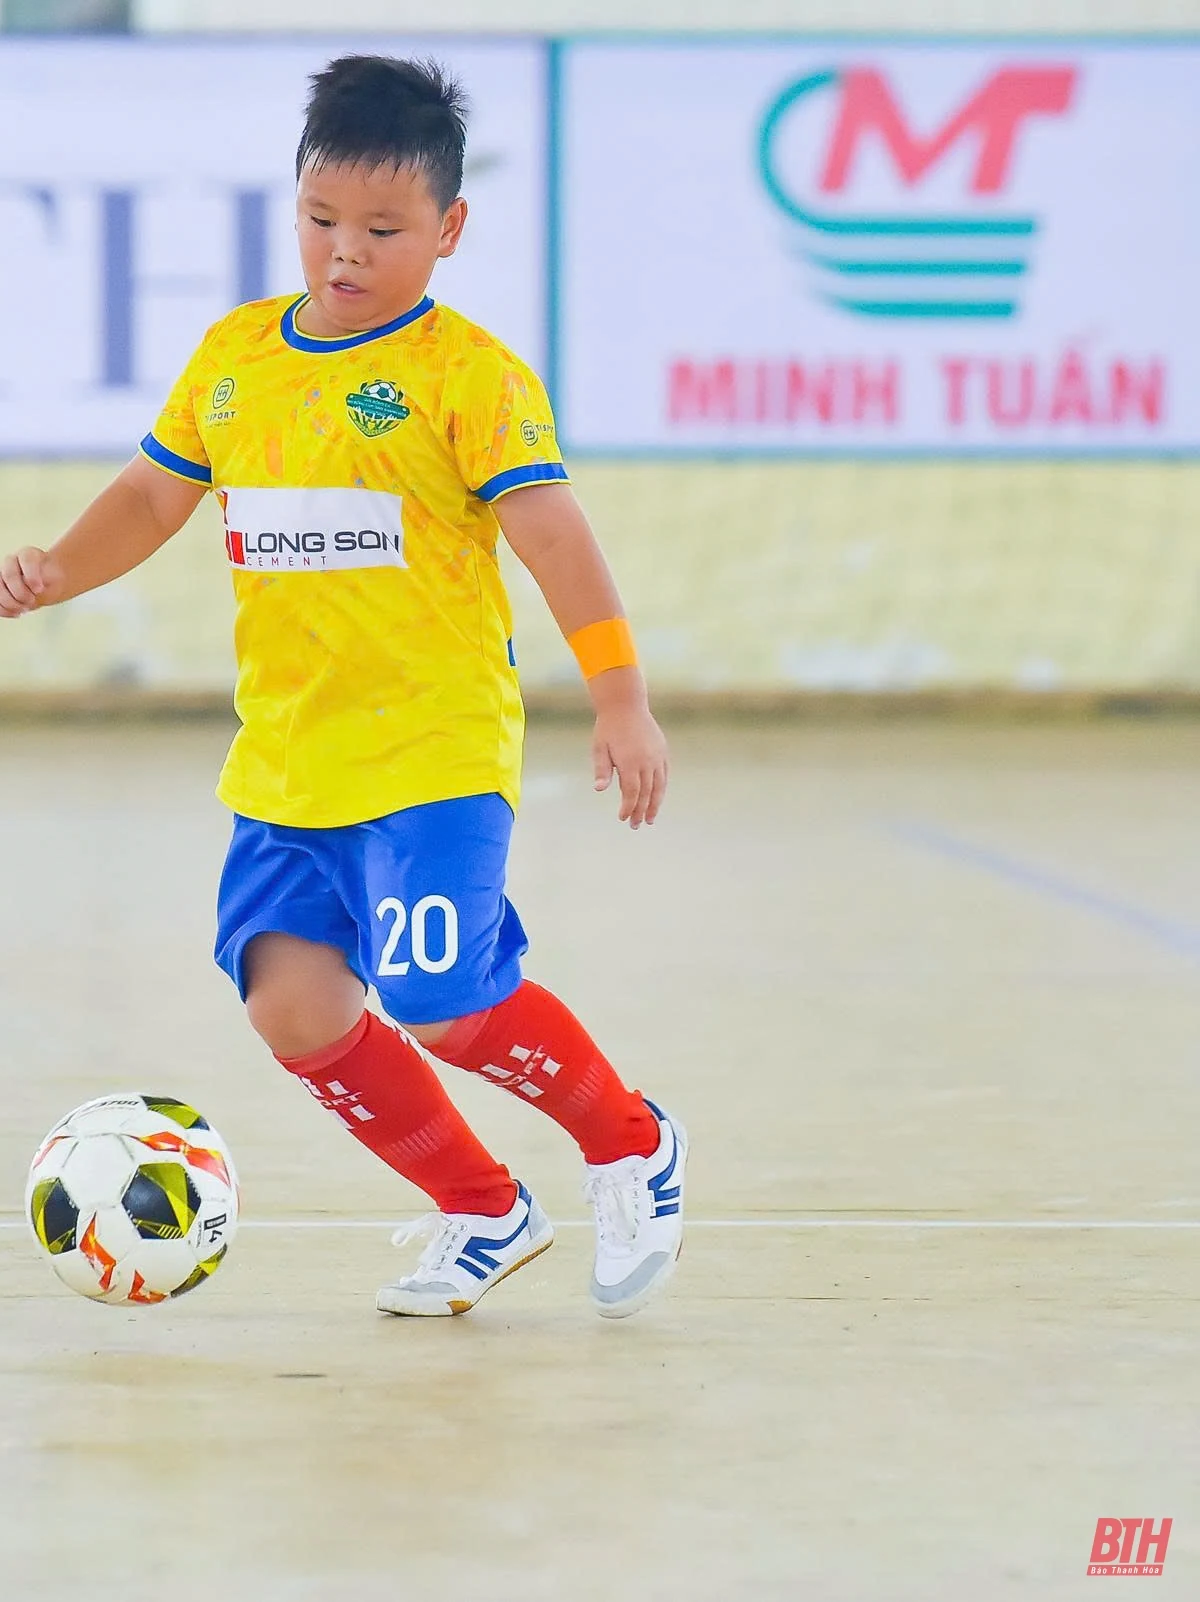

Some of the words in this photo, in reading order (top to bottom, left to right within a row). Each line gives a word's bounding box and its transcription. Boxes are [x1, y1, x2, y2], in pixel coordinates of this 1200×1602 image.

[668, 356, 898, 427] MINH
[245, 532, 326, 553] LONG
[246, 555, 328, 567] CEMENT
[375, 894, 459, 977] 20
